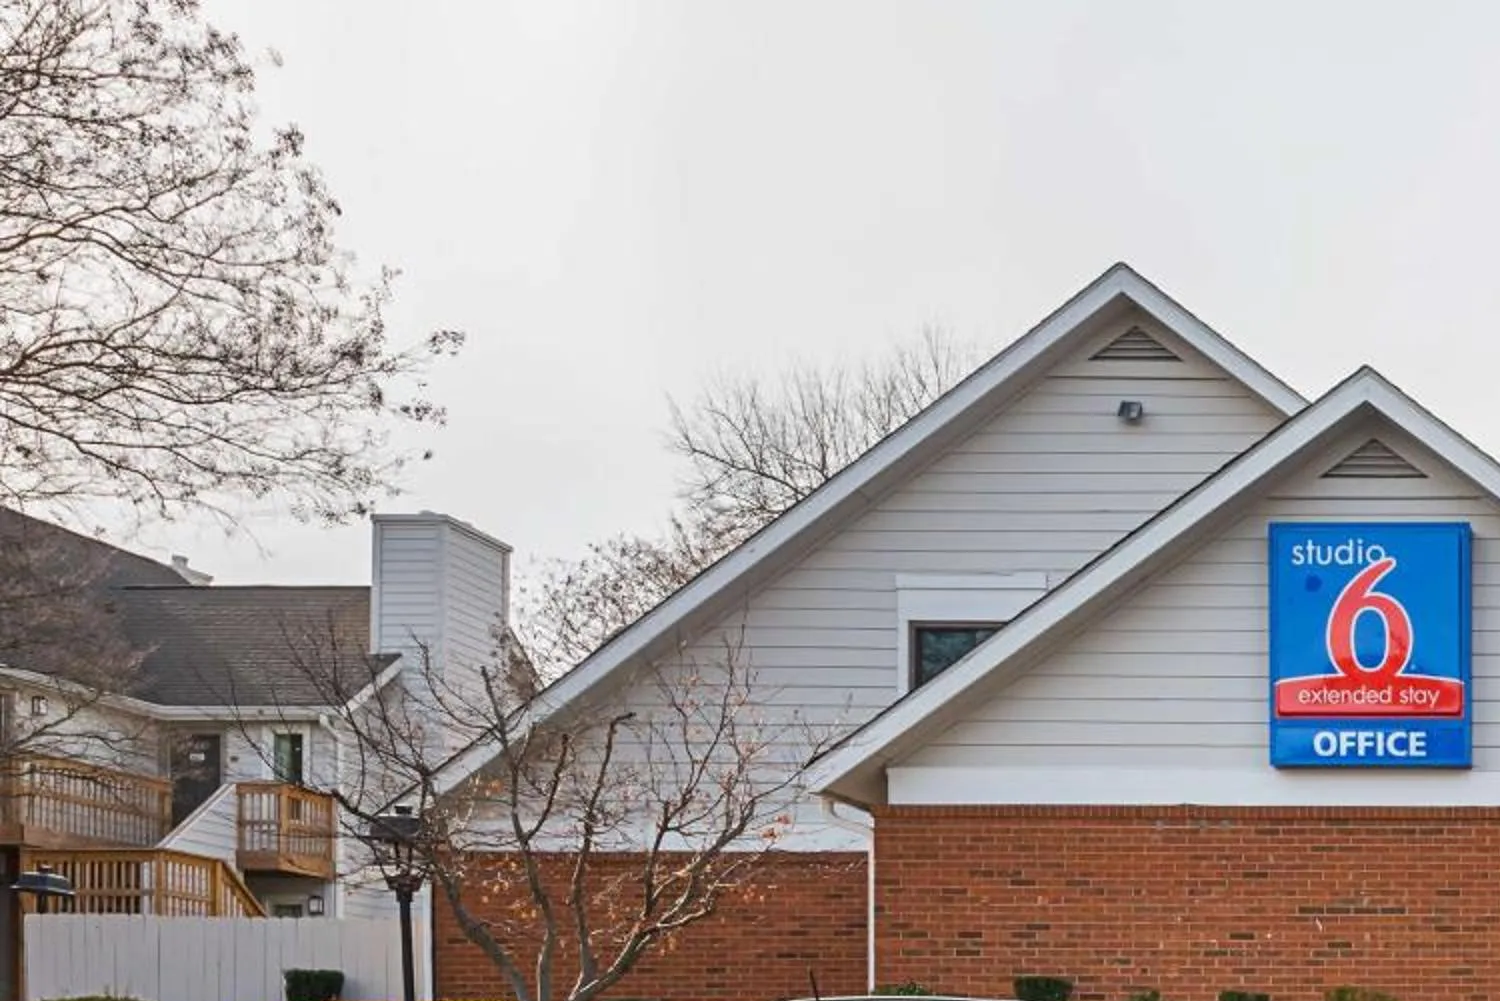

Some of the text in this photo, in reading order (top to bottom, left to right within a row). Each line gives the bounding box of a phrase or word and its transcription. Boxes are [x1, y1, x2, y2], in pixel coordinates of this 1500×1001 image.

[1291, 540, 1386, 565] studio
[1326, 557, 1414, 676] 6
[1298, 685, 1441, 708] extended stay
[1313, 731, 1428, 757] OFFICE
